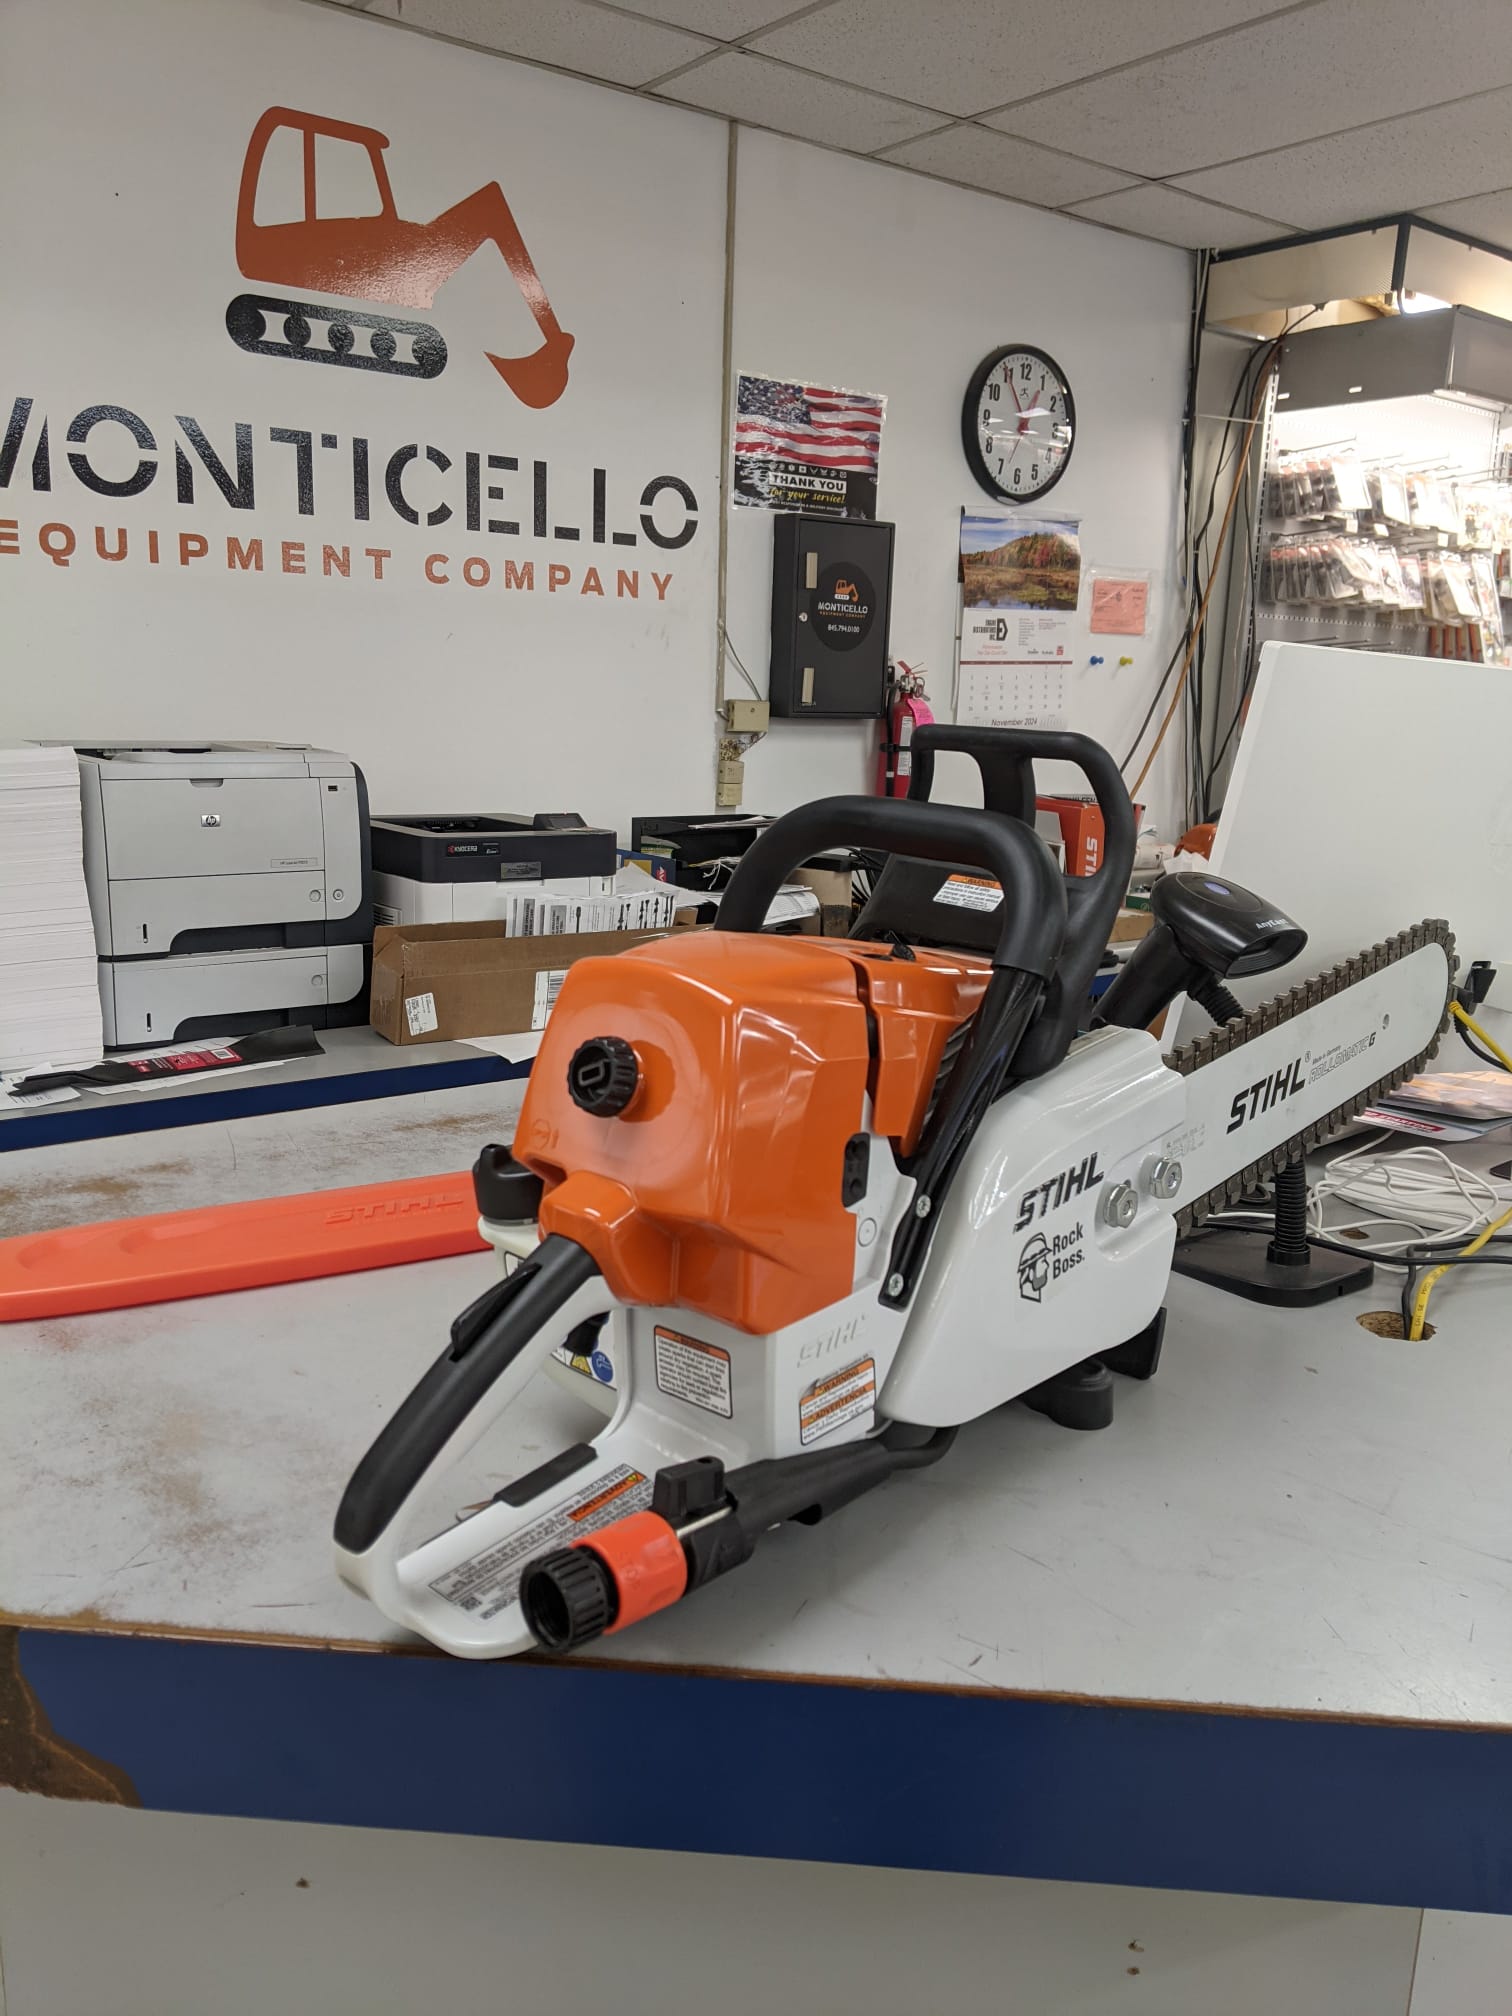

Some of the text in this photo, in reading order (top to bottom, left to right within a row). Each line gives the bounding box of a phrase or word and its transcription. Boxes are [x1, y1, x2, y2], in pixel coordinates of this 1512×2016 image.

[1020, 362, 1032, 381] 12
[1040, 374, 1045, 391] 1
[988, 383, 1000, 401] 10
[1050, 395, 1056, 413] 2
[986, 437, 993, 454] 8
[0, 397, 699, 550] MONTICELLO
[998, 458, 1004, 475] 7
[1031, 464, 1038, 480] 5
[773, 475, 843, 491] THANK YOU
[1013, 468, 1021, 485] 6
[788, 490, 808, 500] your
[813, 493, 846, 504] service!
[0, 519, 673, 600] EQUIPMENT COMPANY
[817, 601, 868, 614] MONTICELLO
[992, 717, 1038, 727] November 2024
[1226, 1057, 1306, 1135] STIHL
[1013, 1151, 1104, 1234] STIHL
[325, 1194, 464, 1225] STIHL
[1052, 1221, 1084, 1256] Rock
[823, 1366, 858, 1392] WARNING
[816, 1385, 865, 1420] ADVERTENCIA
